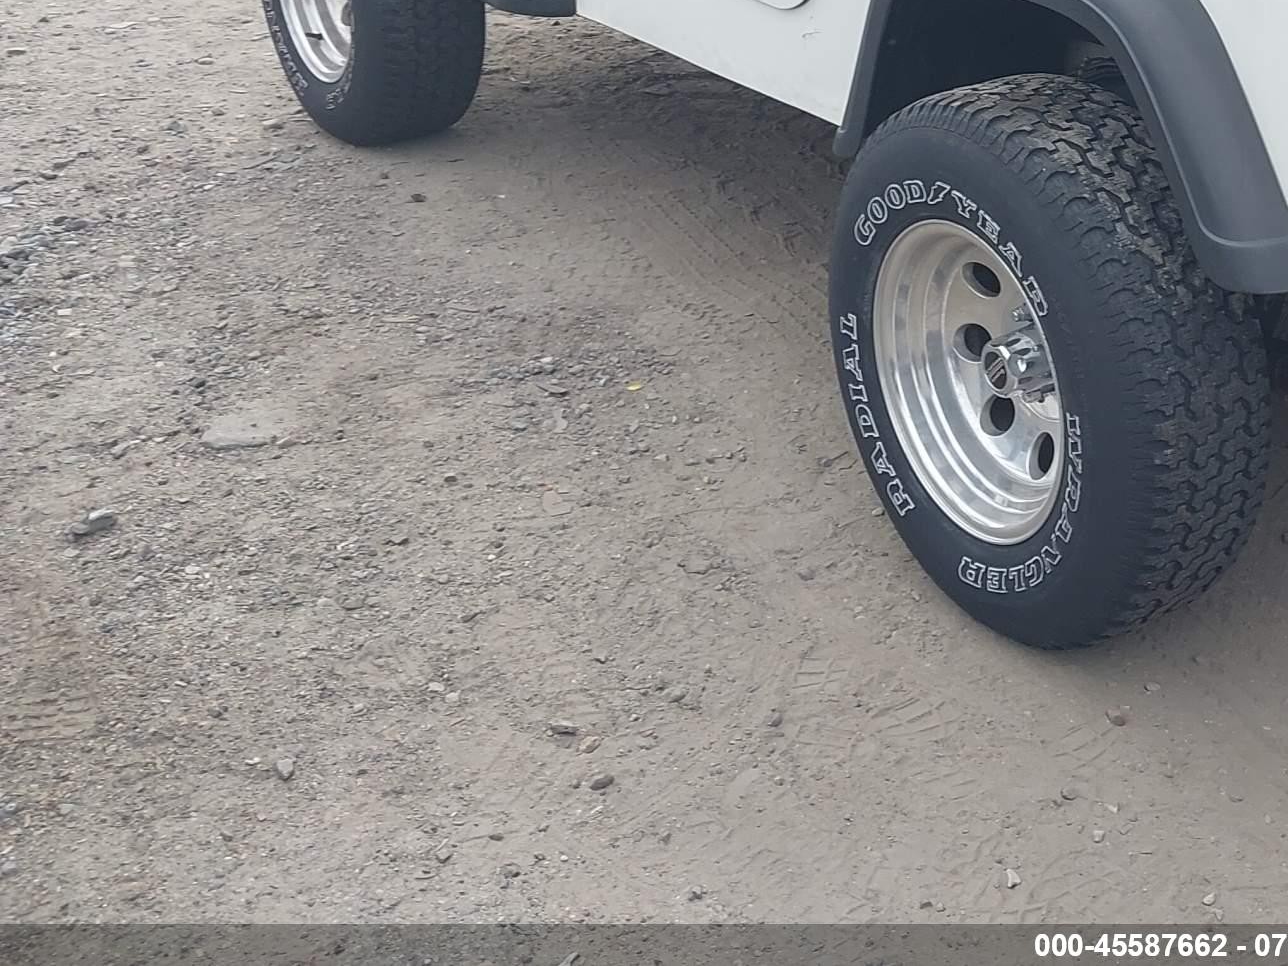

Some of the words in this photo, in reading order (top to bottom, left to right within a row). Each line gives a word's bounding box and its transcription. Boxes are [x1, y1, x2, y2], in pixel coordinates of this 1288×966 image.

[854, 179, 1049, 317] GOODYEAR
[840, 313, 916, 517] RADIAL
[957, 412, 1083, 594] WRANGLER
